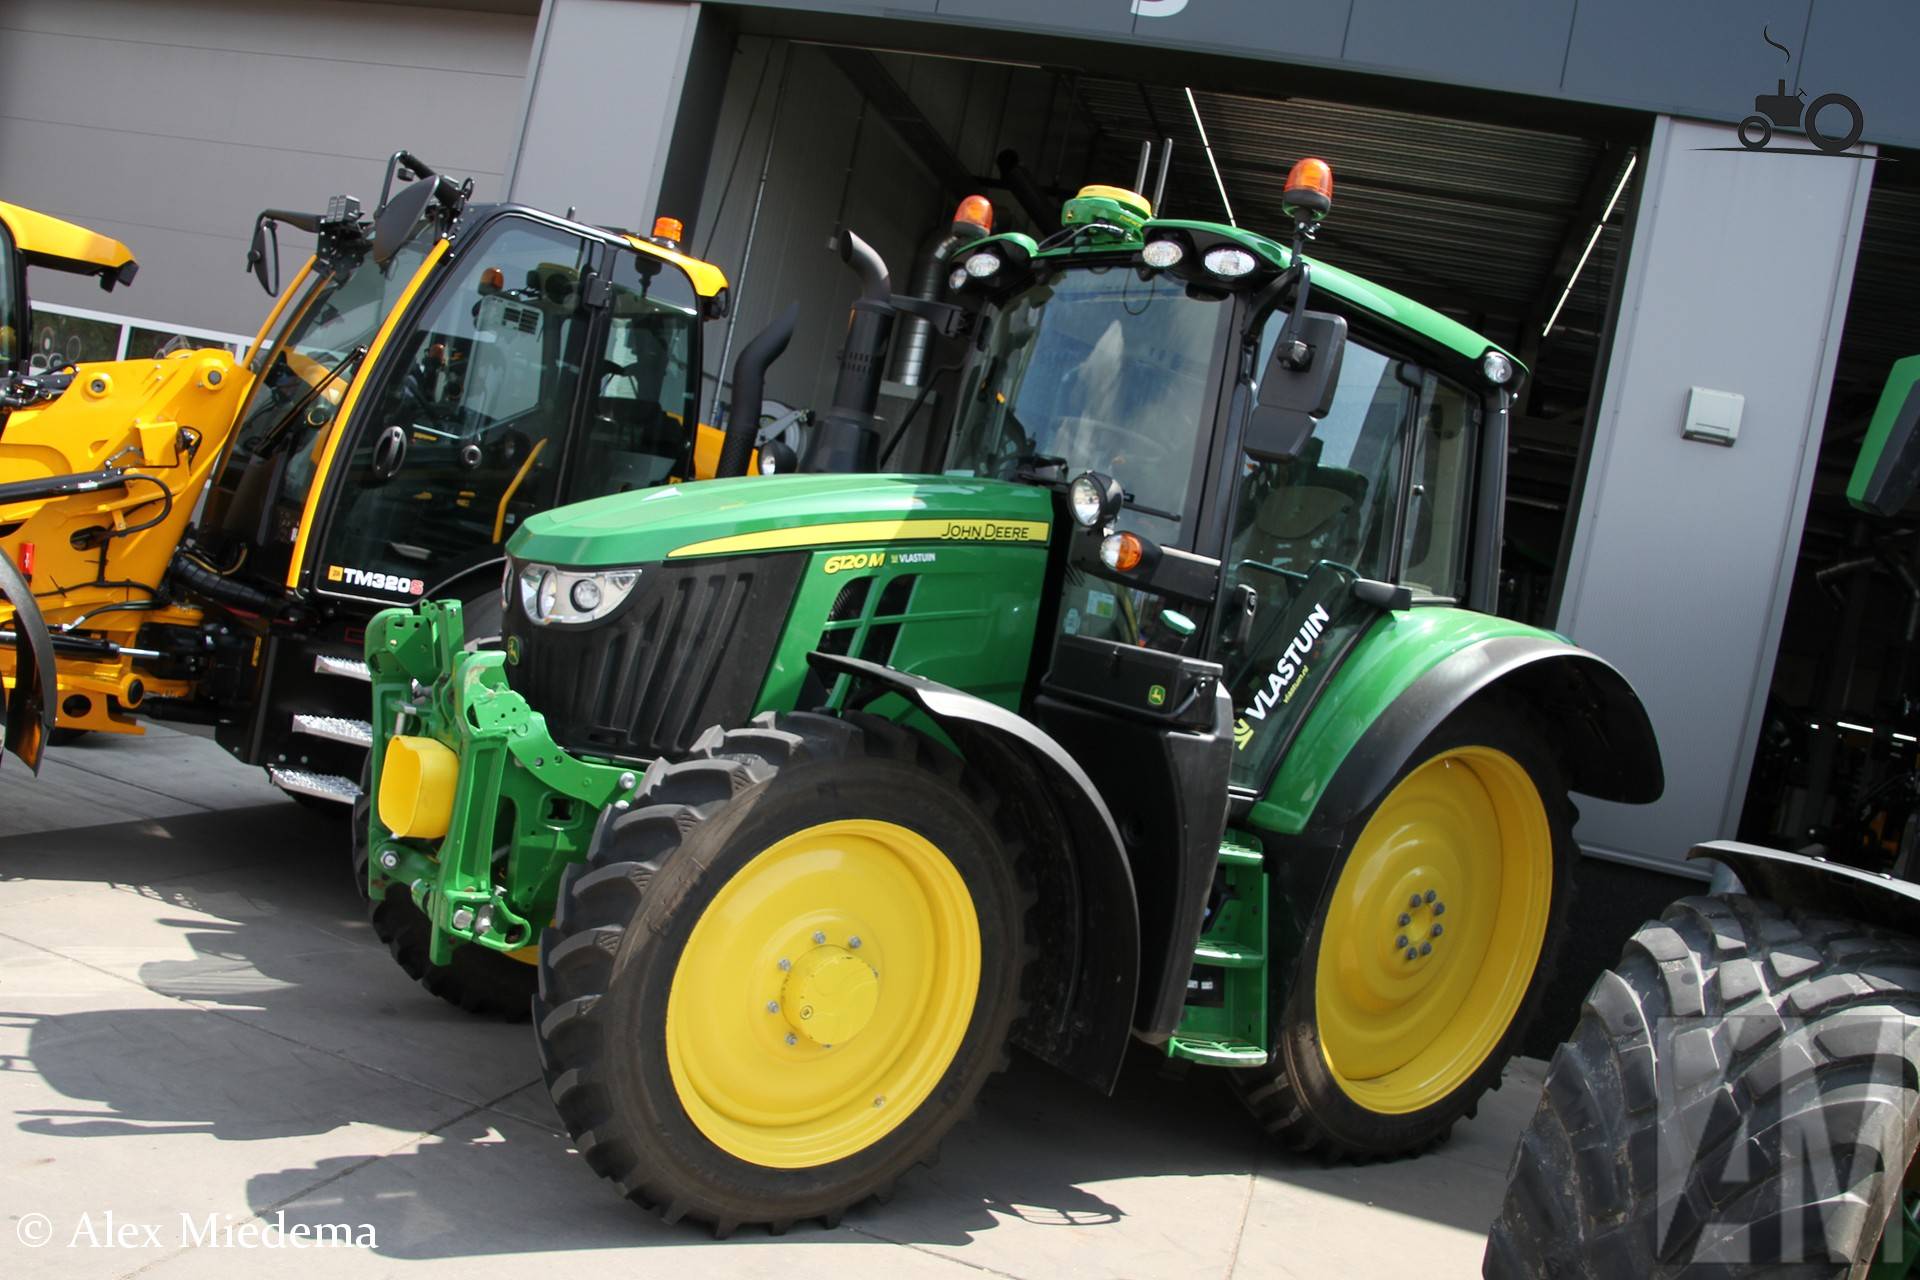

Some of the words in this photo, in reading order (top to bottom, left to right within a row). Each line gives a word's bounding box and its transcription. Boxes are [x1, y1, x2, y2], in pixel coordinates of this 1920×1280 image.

[941, 522, 982, 538] JOHN
[984, 523, 1030, 539] DEERE
[343, 567, 424, 595] TM320S
[1245, 603, 1330, 720] VLASTUIN
